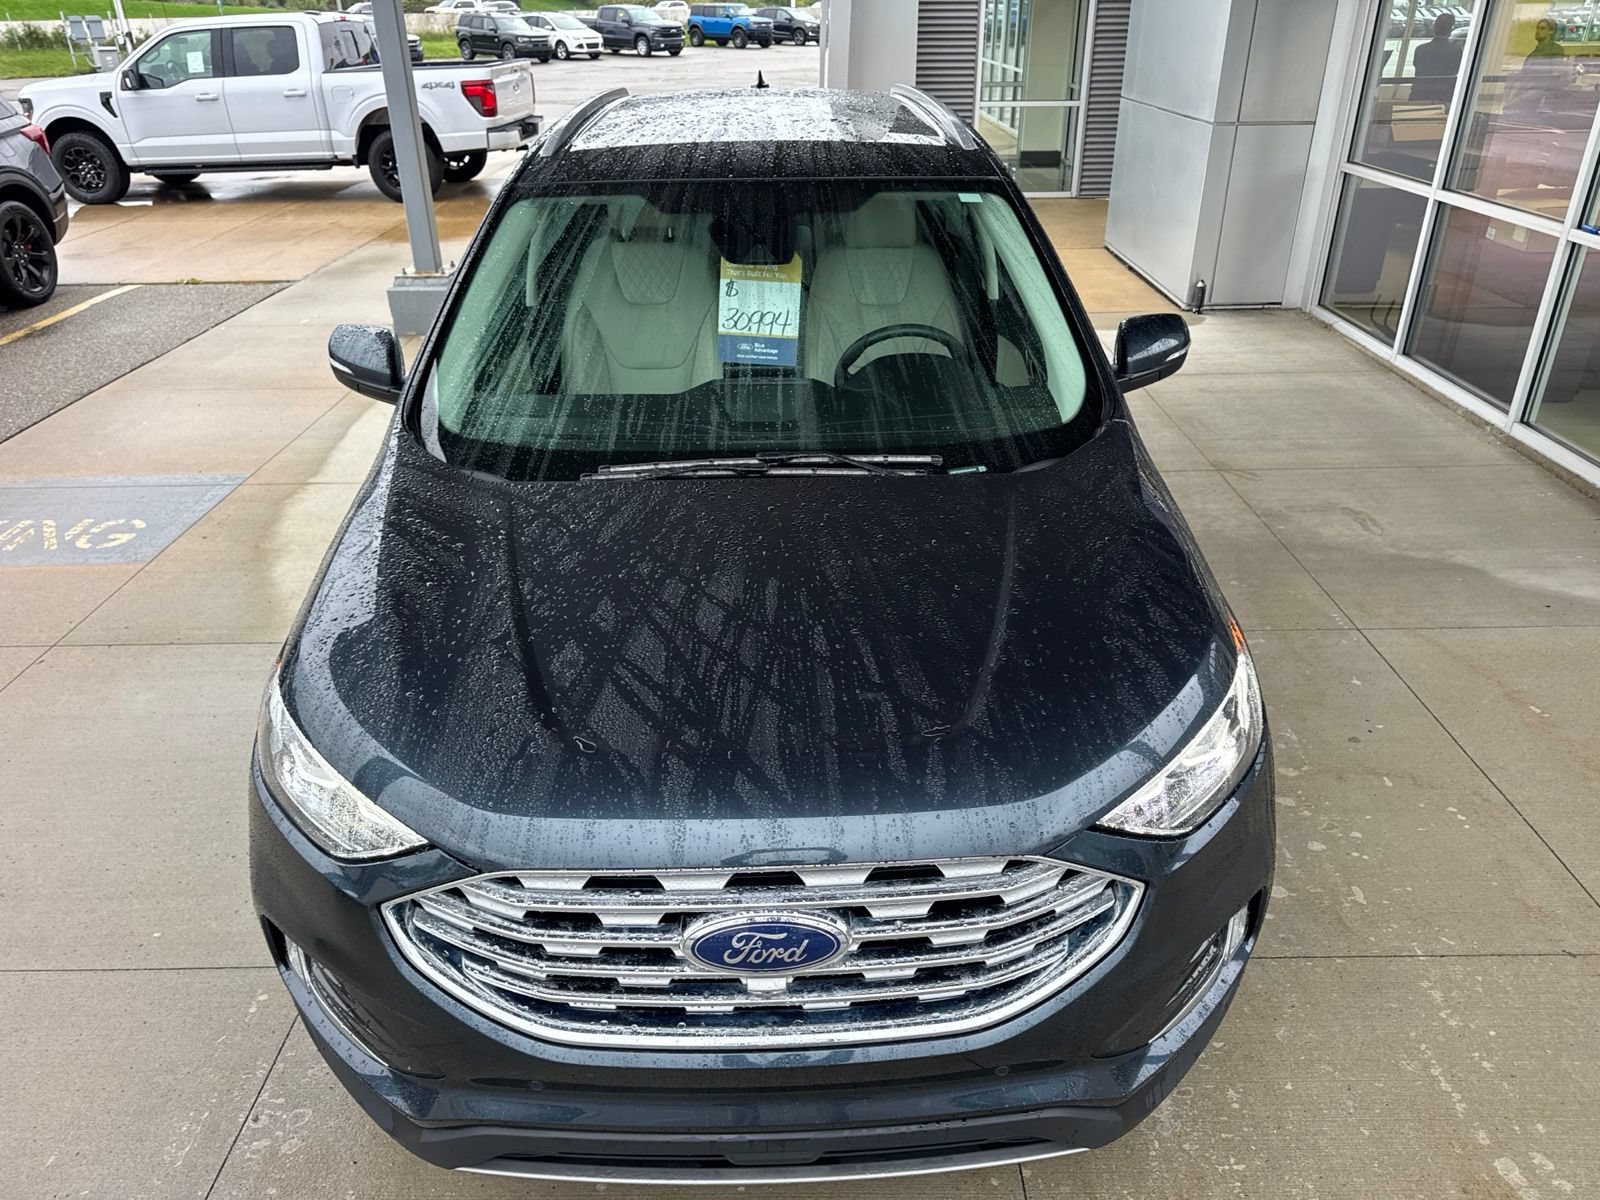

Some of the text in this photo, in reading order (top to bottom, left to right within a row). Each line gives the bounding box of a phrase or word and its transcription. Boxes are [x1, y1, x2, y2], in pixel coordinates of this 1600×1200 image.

[746, 270, 762, 278] Built
[762, 270, 773, 278] For
[754, 347, 778, 355] Advantage
[0, 519, 147, 550] ING
[723, 931, 810, 964] Ford
